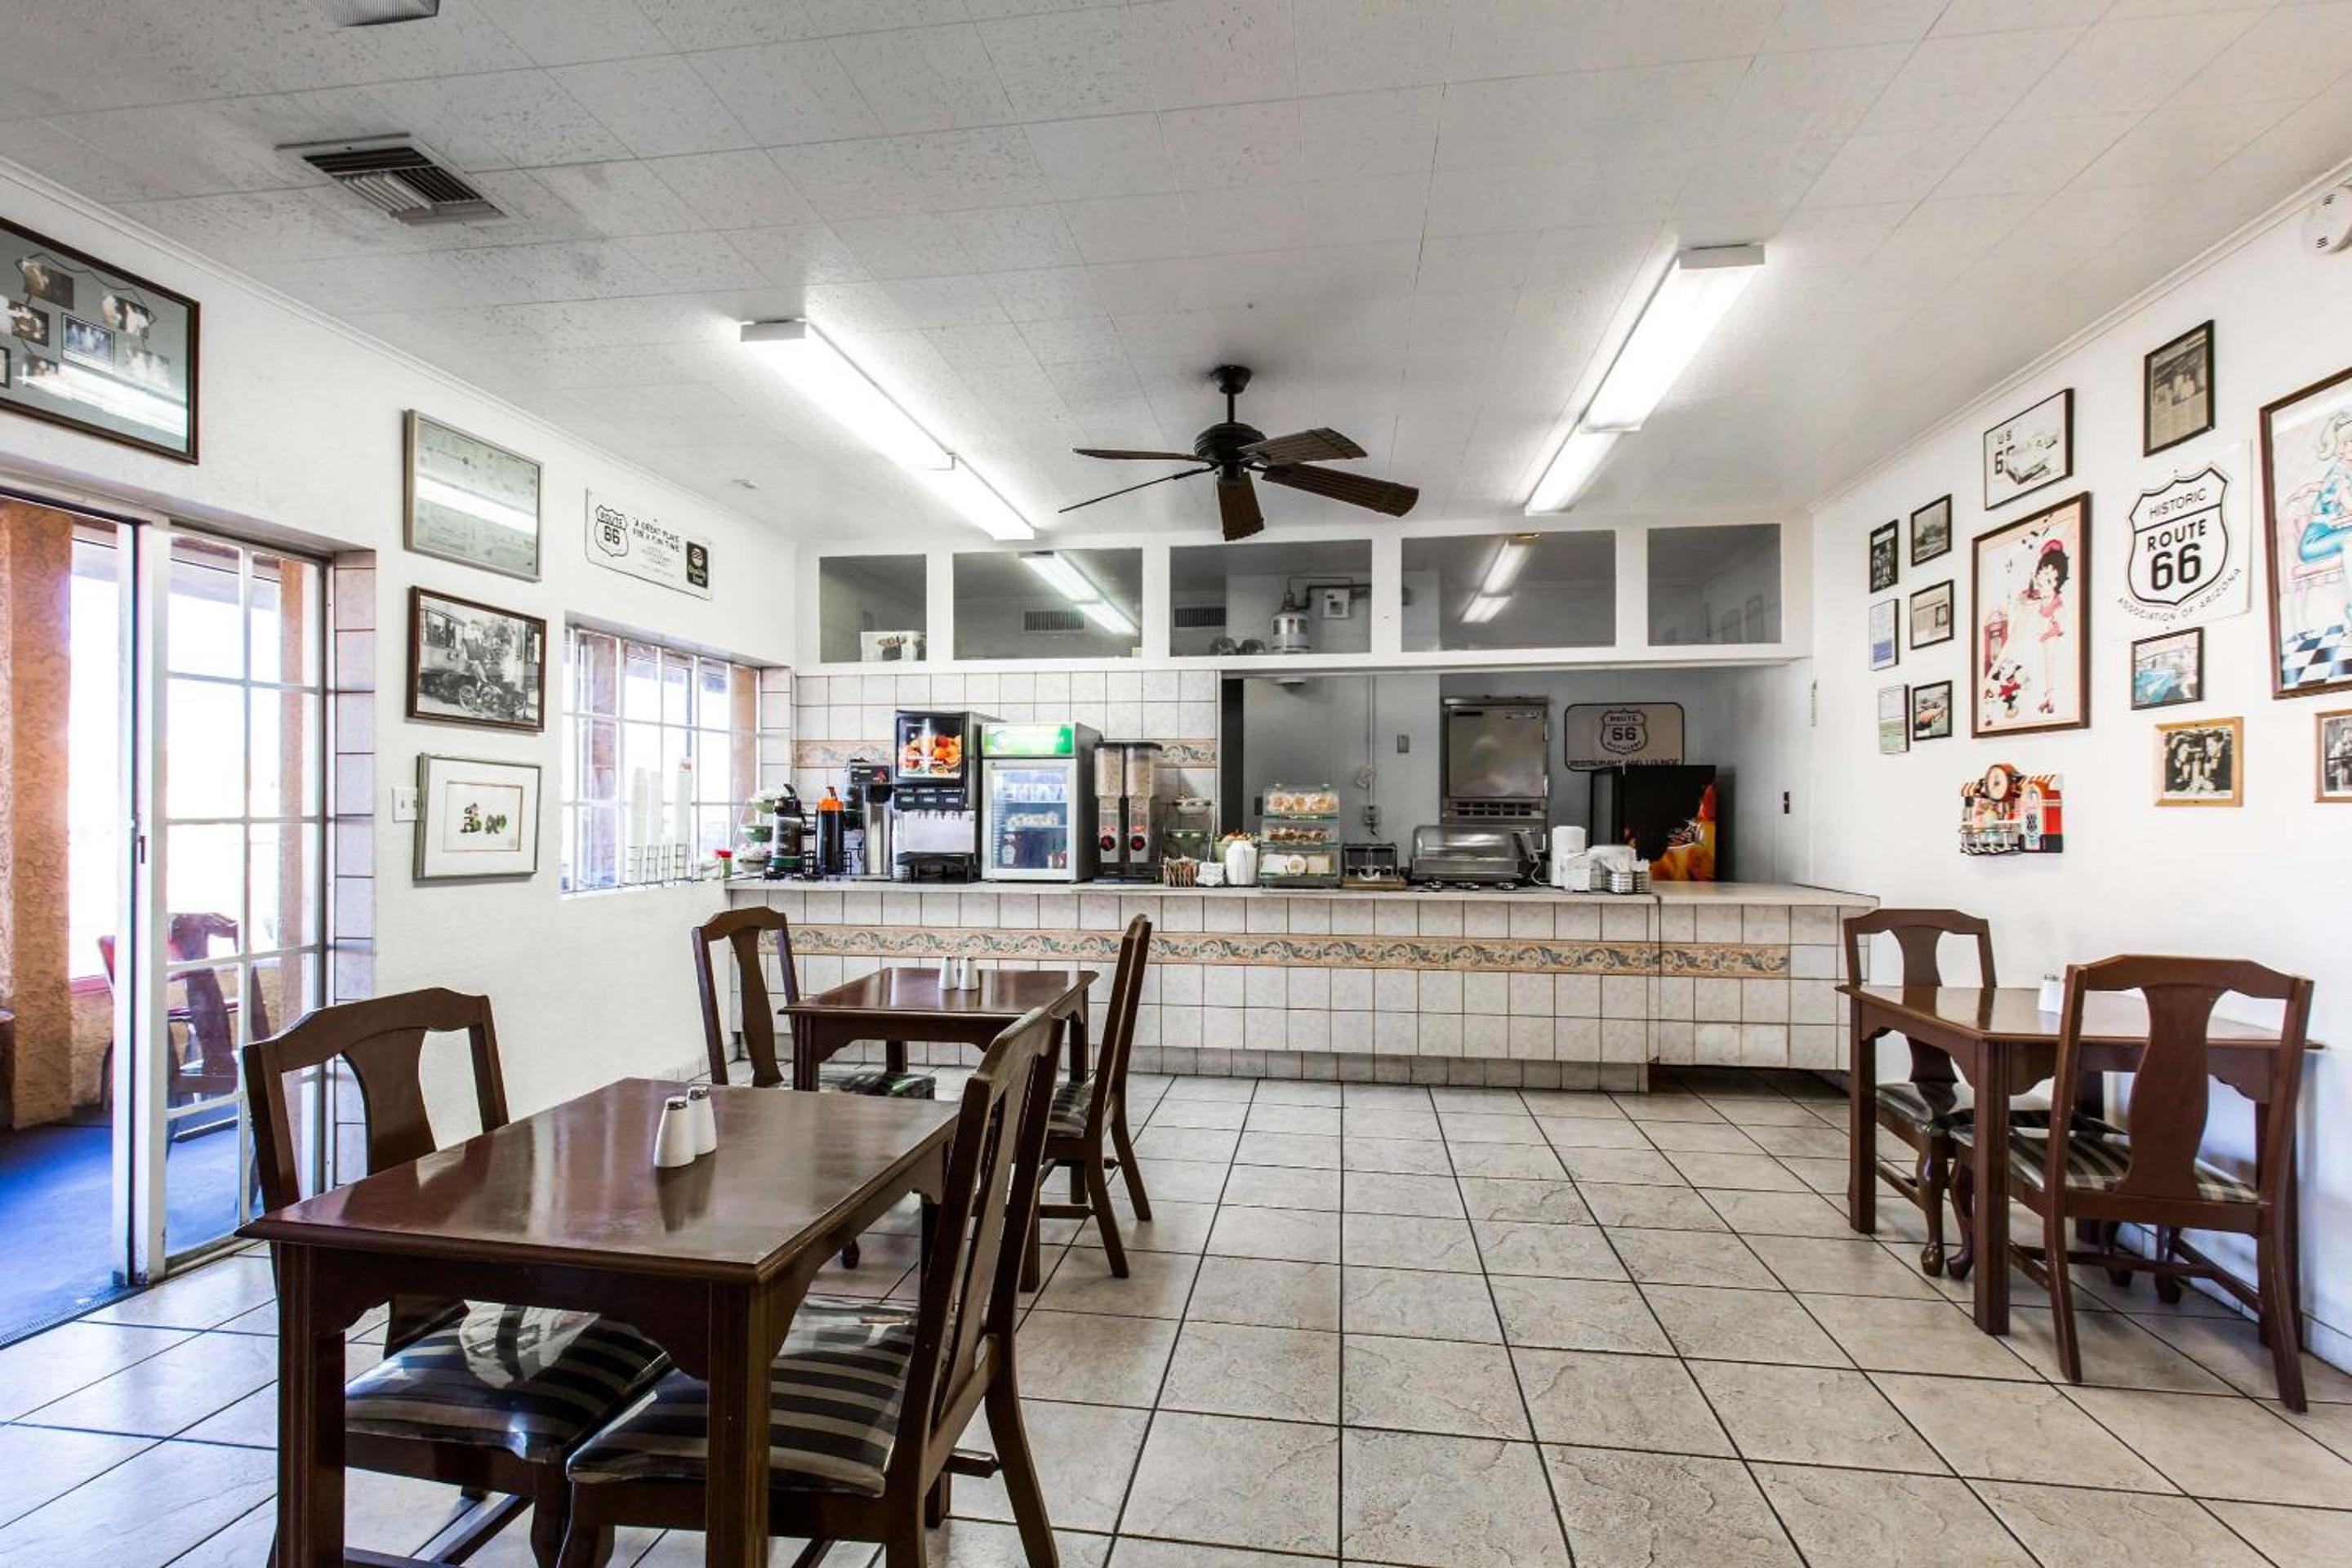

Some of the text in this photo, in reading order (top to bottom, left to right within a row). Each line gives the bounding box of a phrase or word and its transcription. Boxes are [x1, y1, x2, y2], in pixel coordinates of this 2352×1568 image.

[2149, 488, 2207, 517] HISTORIC
[599, 511, 622, 527] ROUTE
[604, 525, 621, 545] 66
[2147, 519, 2207, 552] ROUTE
[2151, 542, 2202, 591] 66
[2117, 568, 2241, 622] ASSOCIATION OF ARIZONA
[1611, 727, 1637, 741] 66
[1569, 759, 1623, 767] RESTAURANT
